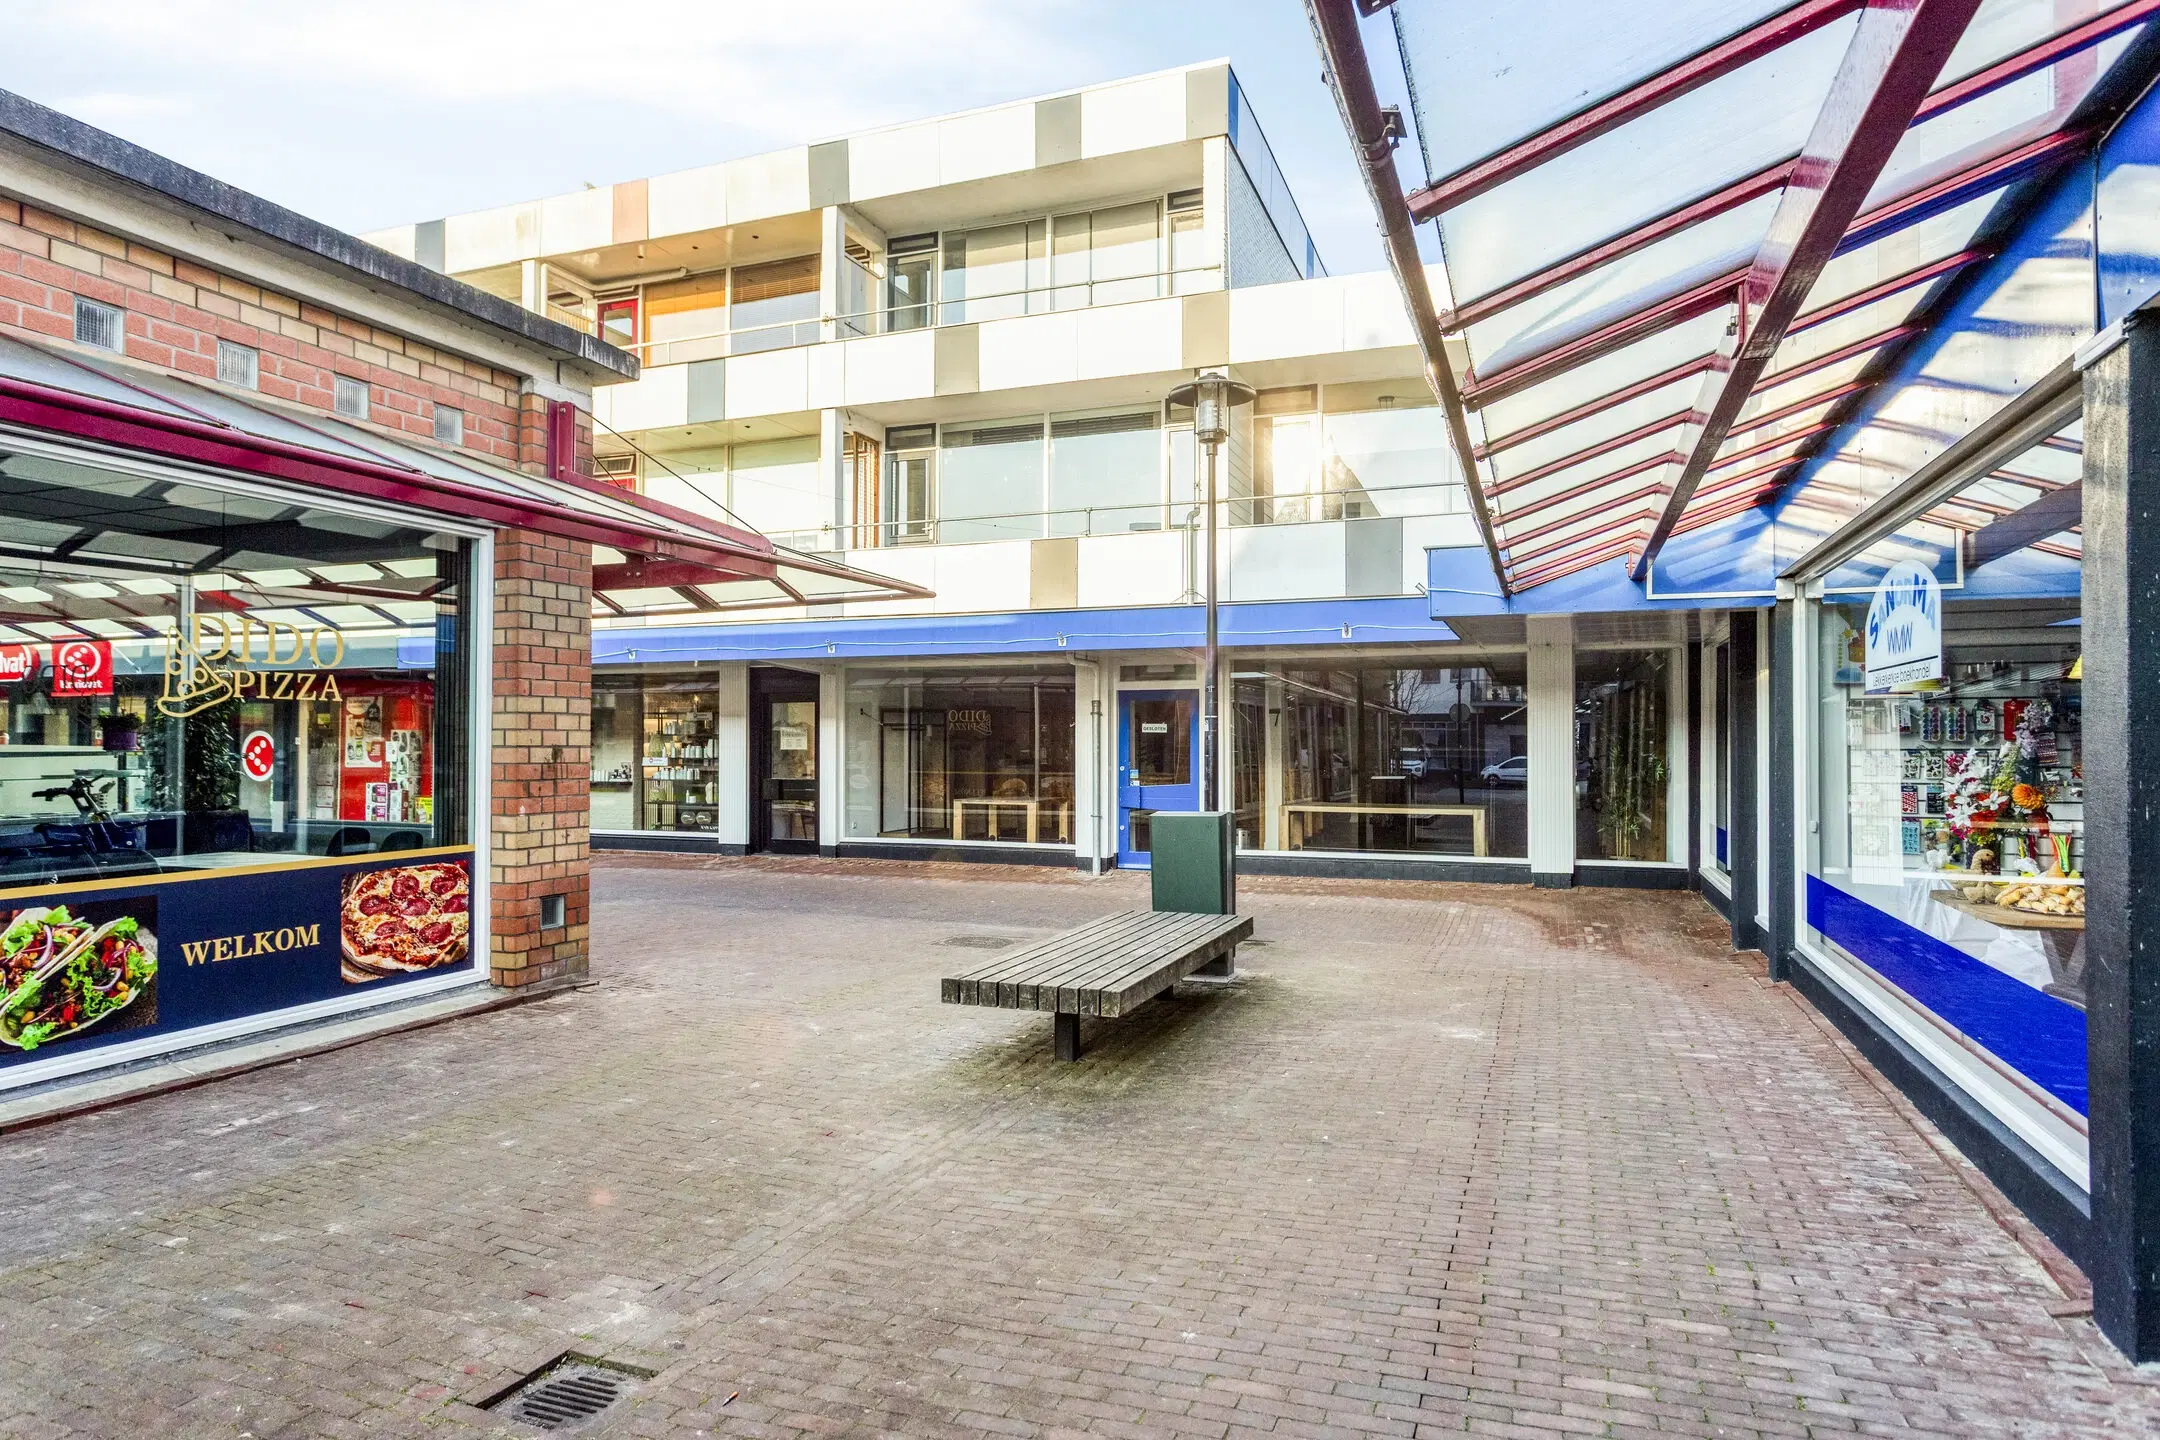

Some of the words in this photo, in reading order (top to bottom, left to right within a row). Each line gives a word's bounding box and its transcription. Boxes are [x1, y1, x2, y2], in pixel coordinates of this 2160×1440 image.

[1869, 573, 1936, 649] SANORMA
[187, 613, 345, 669] DIDO
[231, 669, 343, 702] PIZZA
[180, 923, 321, 967] WELKOM
